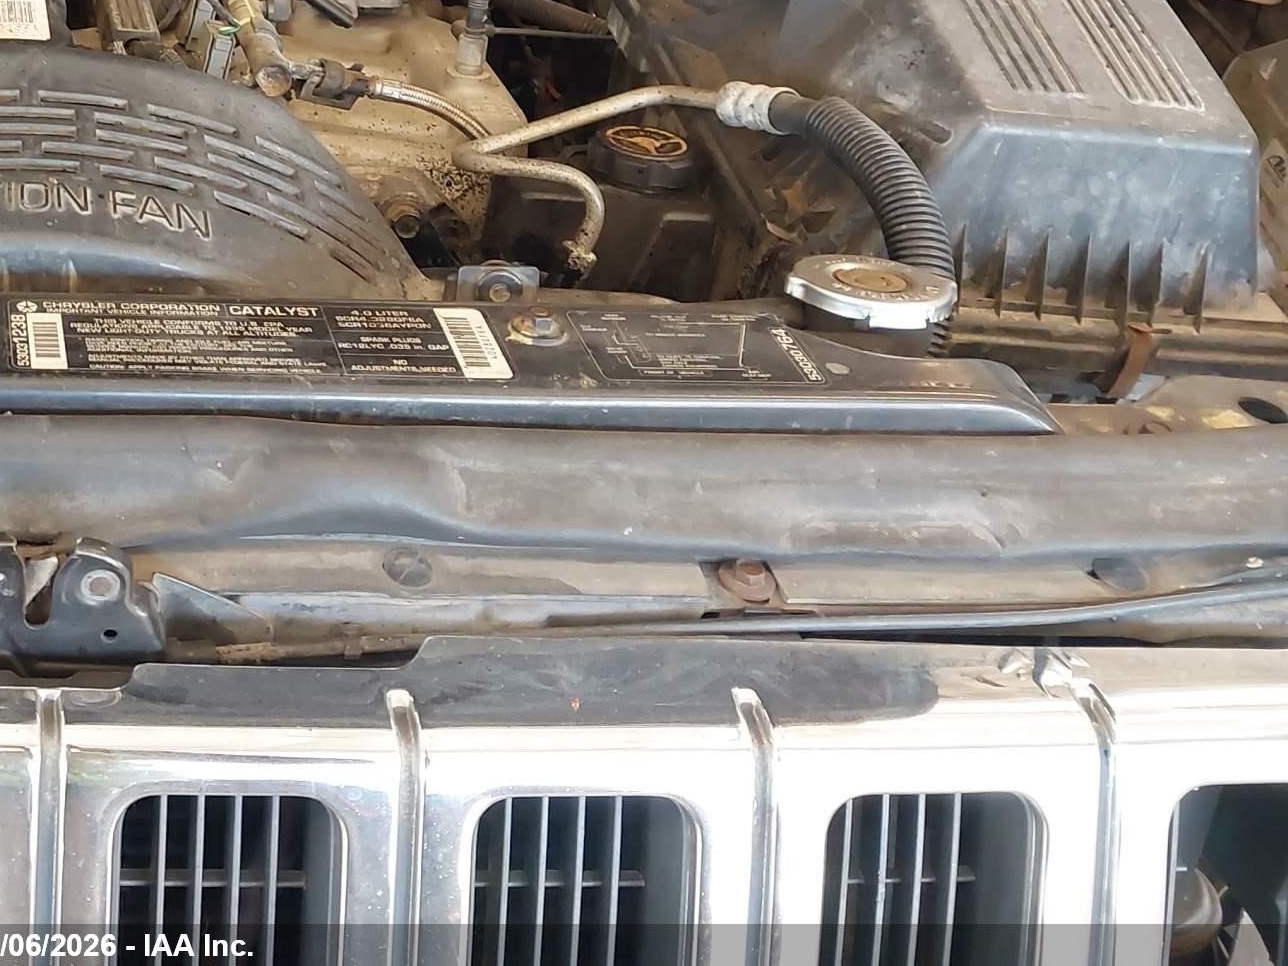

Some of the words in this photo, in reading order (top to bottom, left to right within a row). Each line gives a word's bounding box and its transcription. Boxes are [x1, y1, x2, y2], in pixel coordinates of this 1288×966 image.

[109, 189, 212, 241] FAN
[43, 301, 116, 309] CHRYSLER
[121, 302, 220, 312] CORPORATION
[229, 306, 319, 316] CATALYST
[11, 314, 30, 366] 53031238
[771, 327, 822, 382] 53030764
